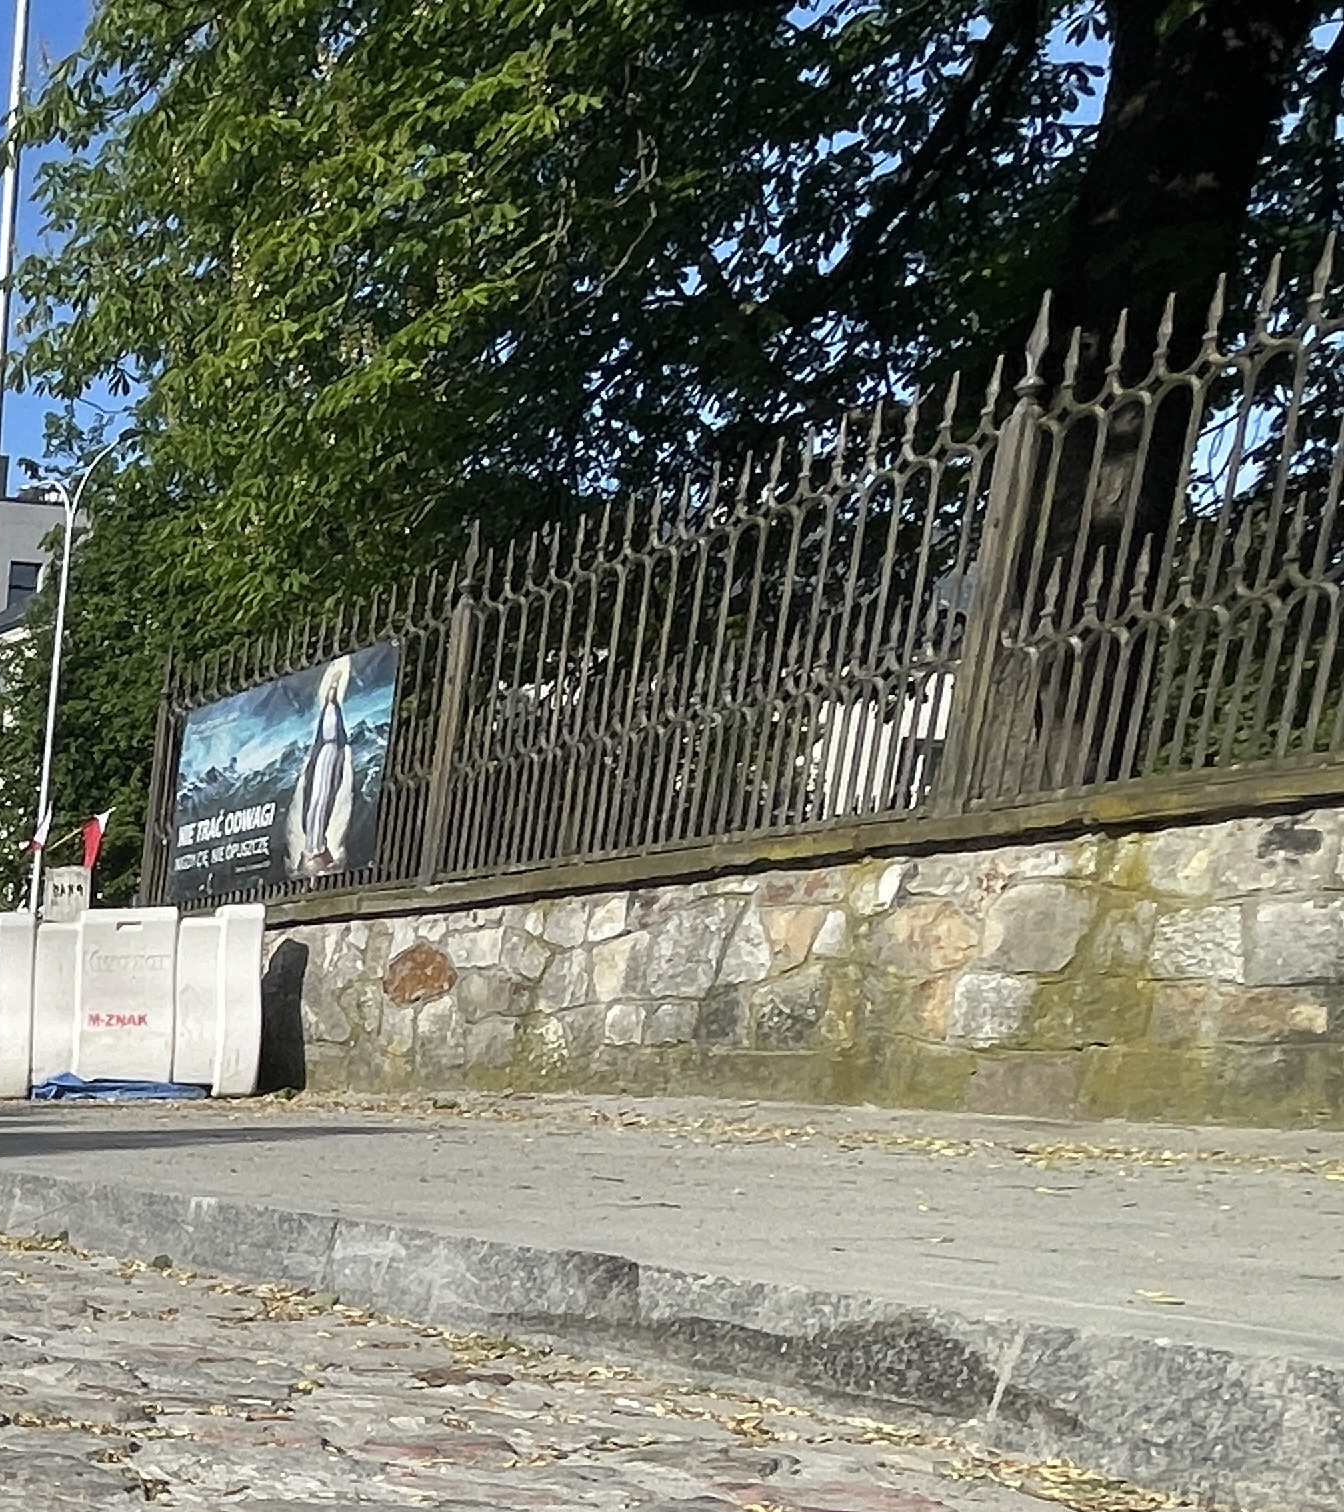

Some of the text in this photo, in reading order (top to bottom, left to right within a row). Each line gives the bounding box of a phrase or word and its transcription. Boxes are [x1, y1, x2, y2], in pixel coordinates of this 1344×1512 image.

[196, 809, 225, 843] TRAĆ
[224, 802, 276, 836] ODWAGI
[87, 1012, 148, 1029] M-ZNAK
